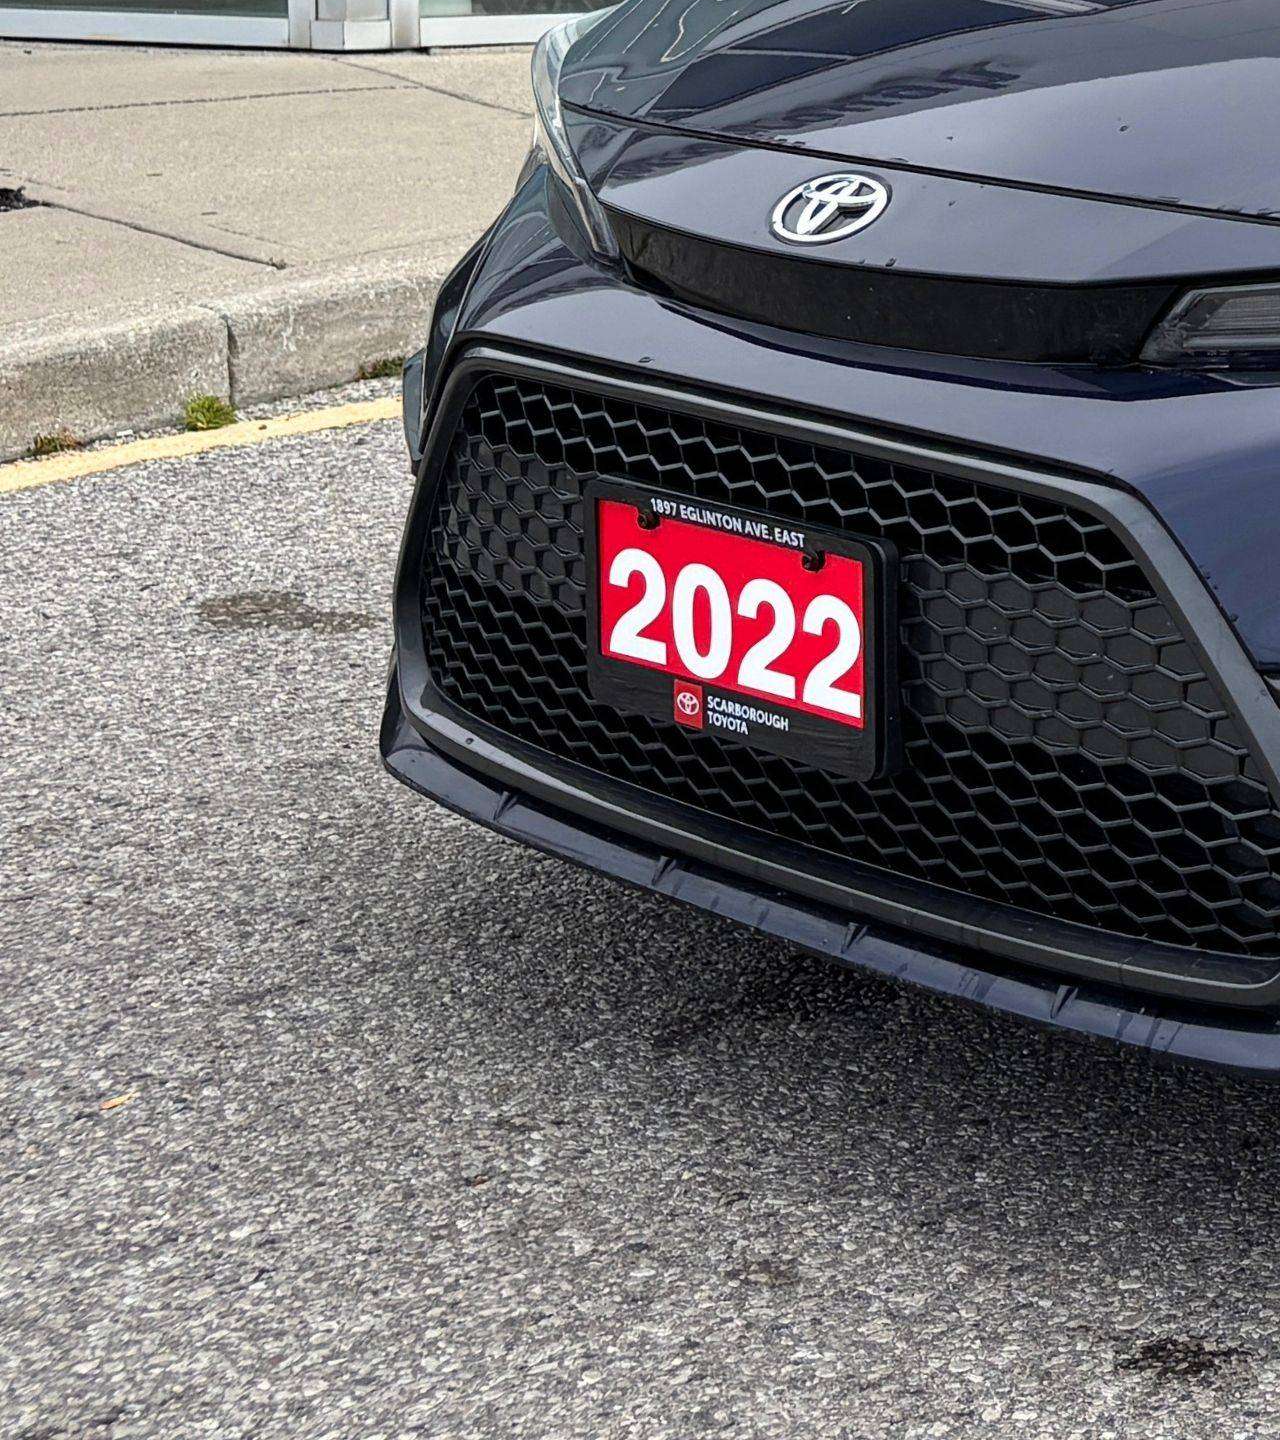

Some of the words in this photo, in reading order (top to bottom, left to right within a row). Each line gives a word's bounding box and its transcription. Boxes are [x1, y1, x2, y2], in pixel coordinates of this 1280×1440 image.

[650, 498, 677, 516] 1897
[679, 504, 742, 533] EGLINTON
[744, 520, 773, 540] AVE.
[774, 527, 805, 547] EAST
[608, 547, 861, 719] 2022
[707, 695, 789, 731] SCARBOROUGH
[707, 710, 749, 735] TOYOTA
